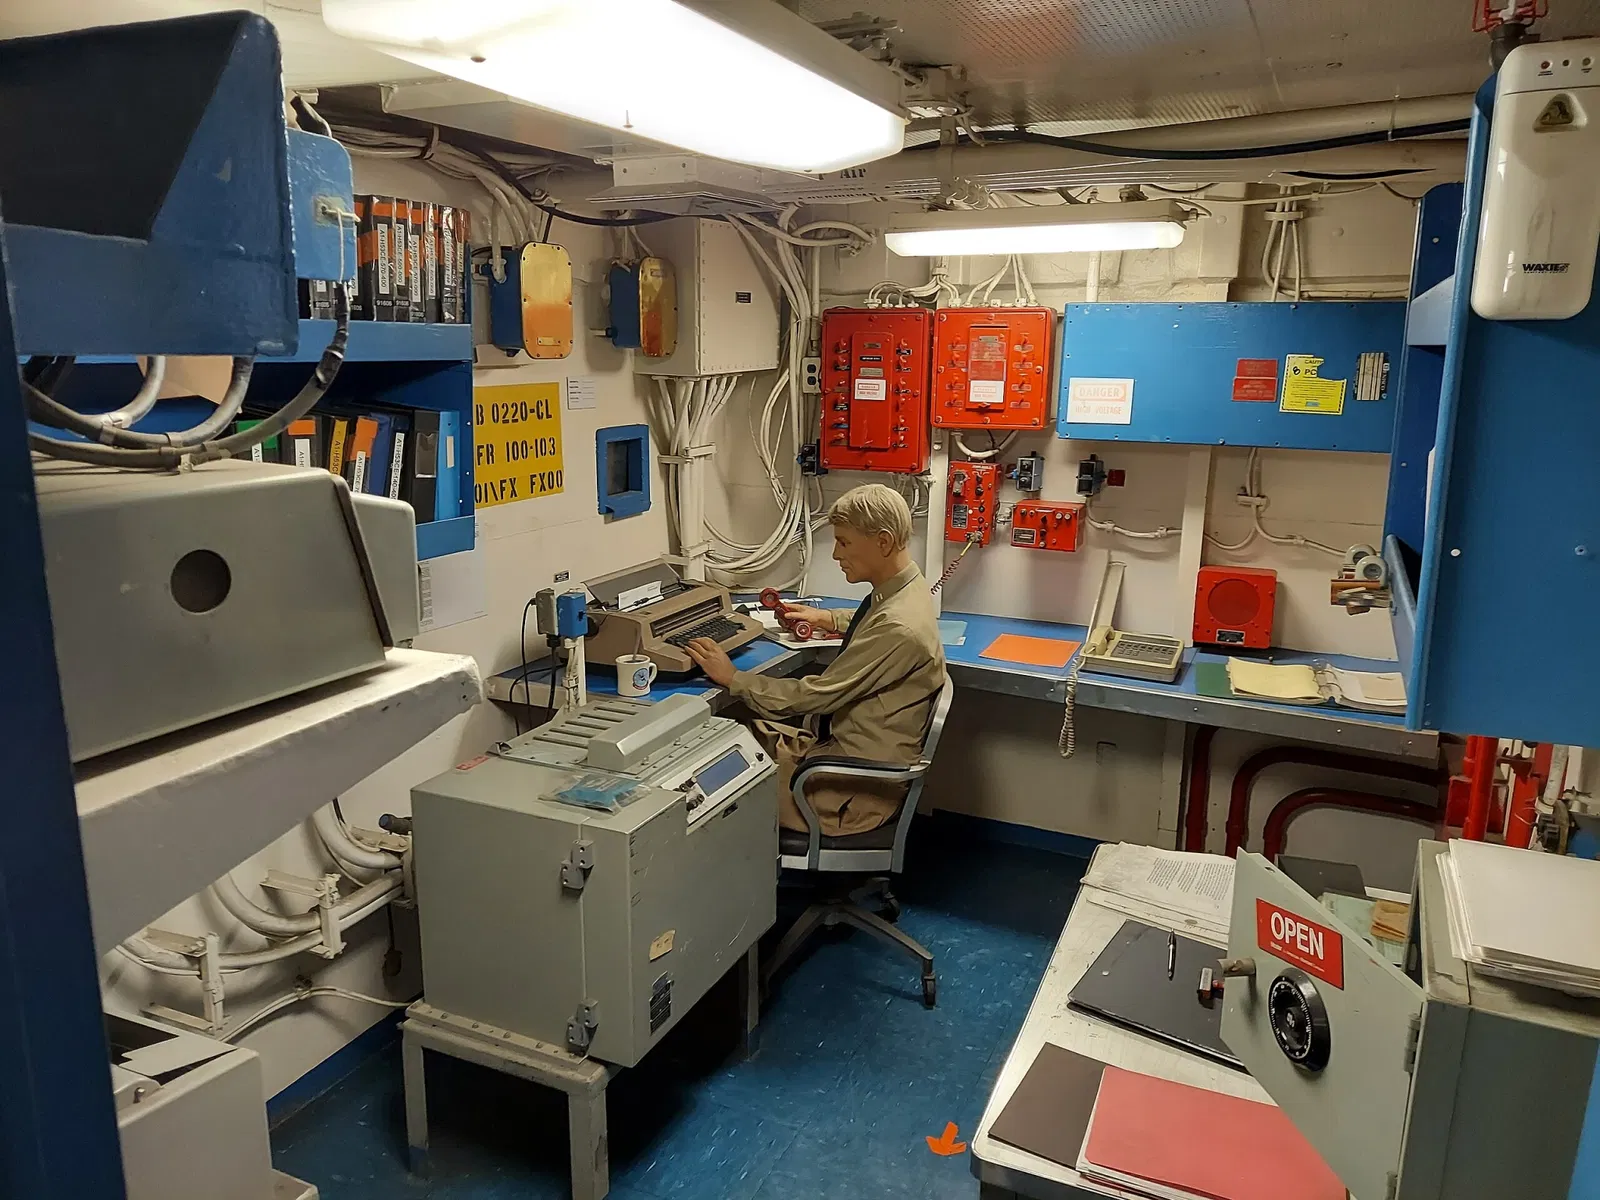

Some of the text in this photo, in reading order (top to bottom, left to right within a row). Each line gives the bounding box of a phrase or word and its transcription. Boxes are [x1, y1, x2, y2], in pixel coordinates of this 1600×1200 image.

[840, 168, 866, 179] Air
[1522, 263, 1566, 272] WAXIE
[1079, 387, 1120, 397] DANGER
[491, 399, 553, 424] 0220-CL
[1095, 405, 1122, 415] VOLTAGE
[476, 443, 495, 466] FR
[1270, 911, 1324, 960] OPEN
